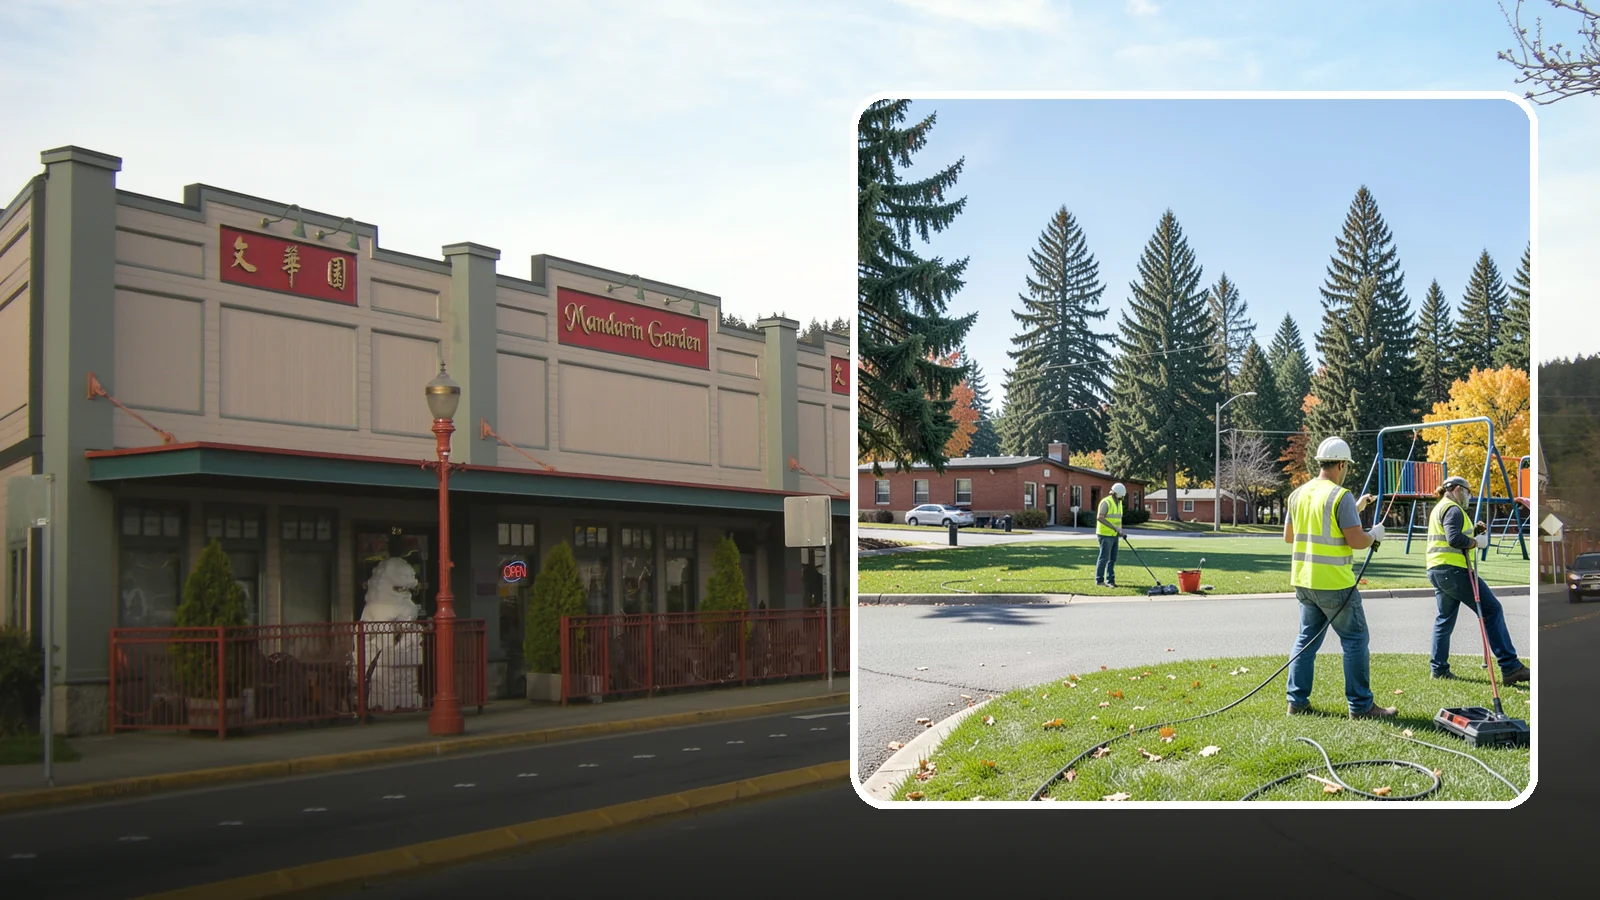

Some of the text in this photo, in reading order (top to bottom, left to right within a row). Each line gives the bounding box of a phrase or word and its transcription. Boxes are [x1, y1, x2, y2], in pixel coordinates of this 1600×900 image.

[564, 302, 701, 352] Mandarin Garden
[503, 565, 527, 578] OPEN
